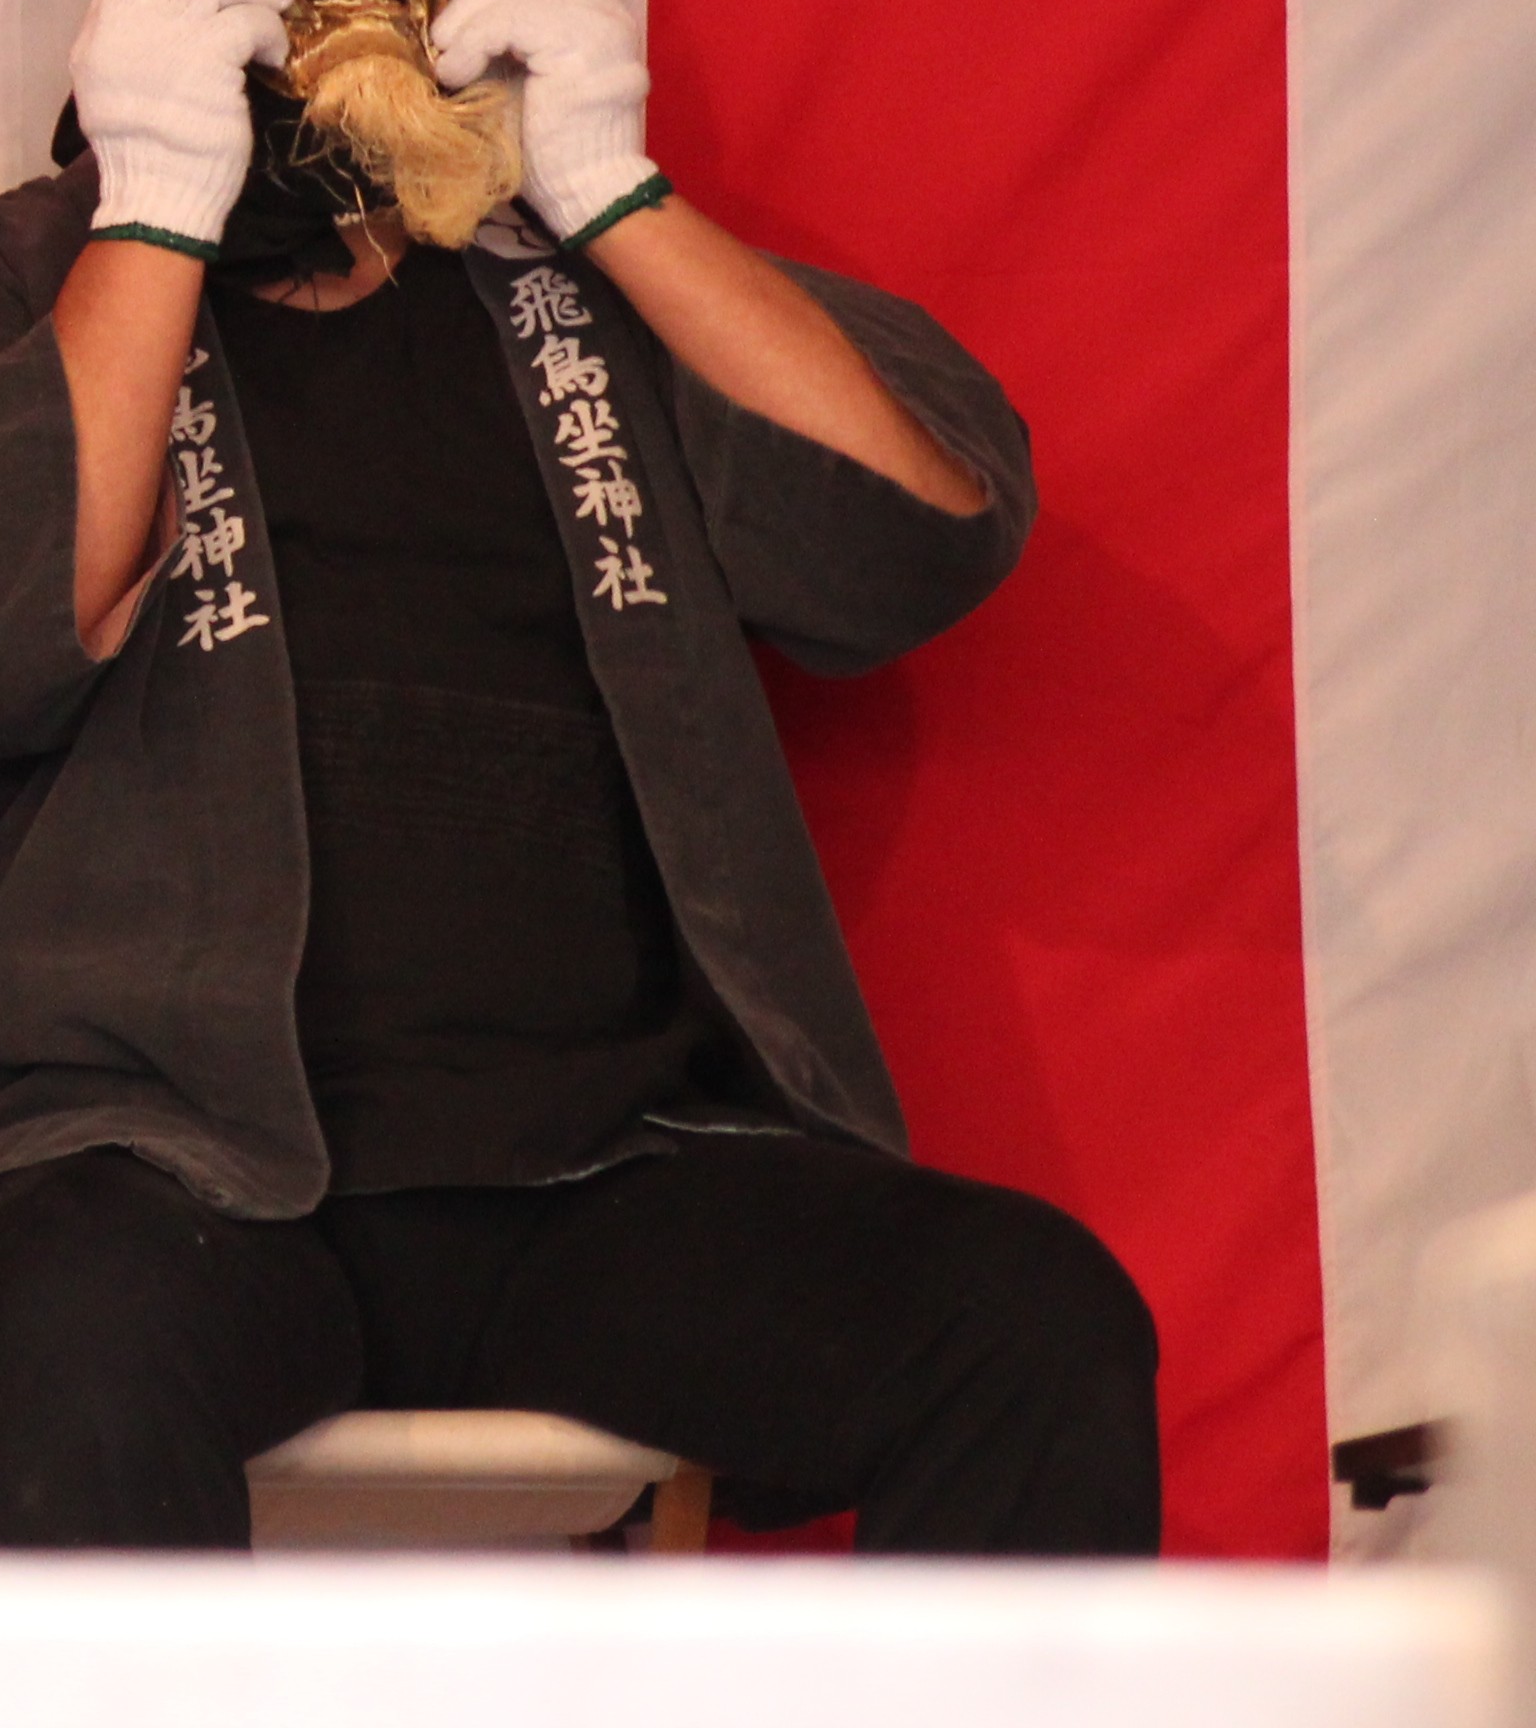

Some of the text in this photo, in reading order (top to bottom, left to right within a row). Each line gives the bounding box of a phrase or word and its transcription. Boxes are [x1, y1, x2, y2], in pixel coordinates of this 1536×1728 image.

[508, 264, 669, 612] 飛鳥坐神社
